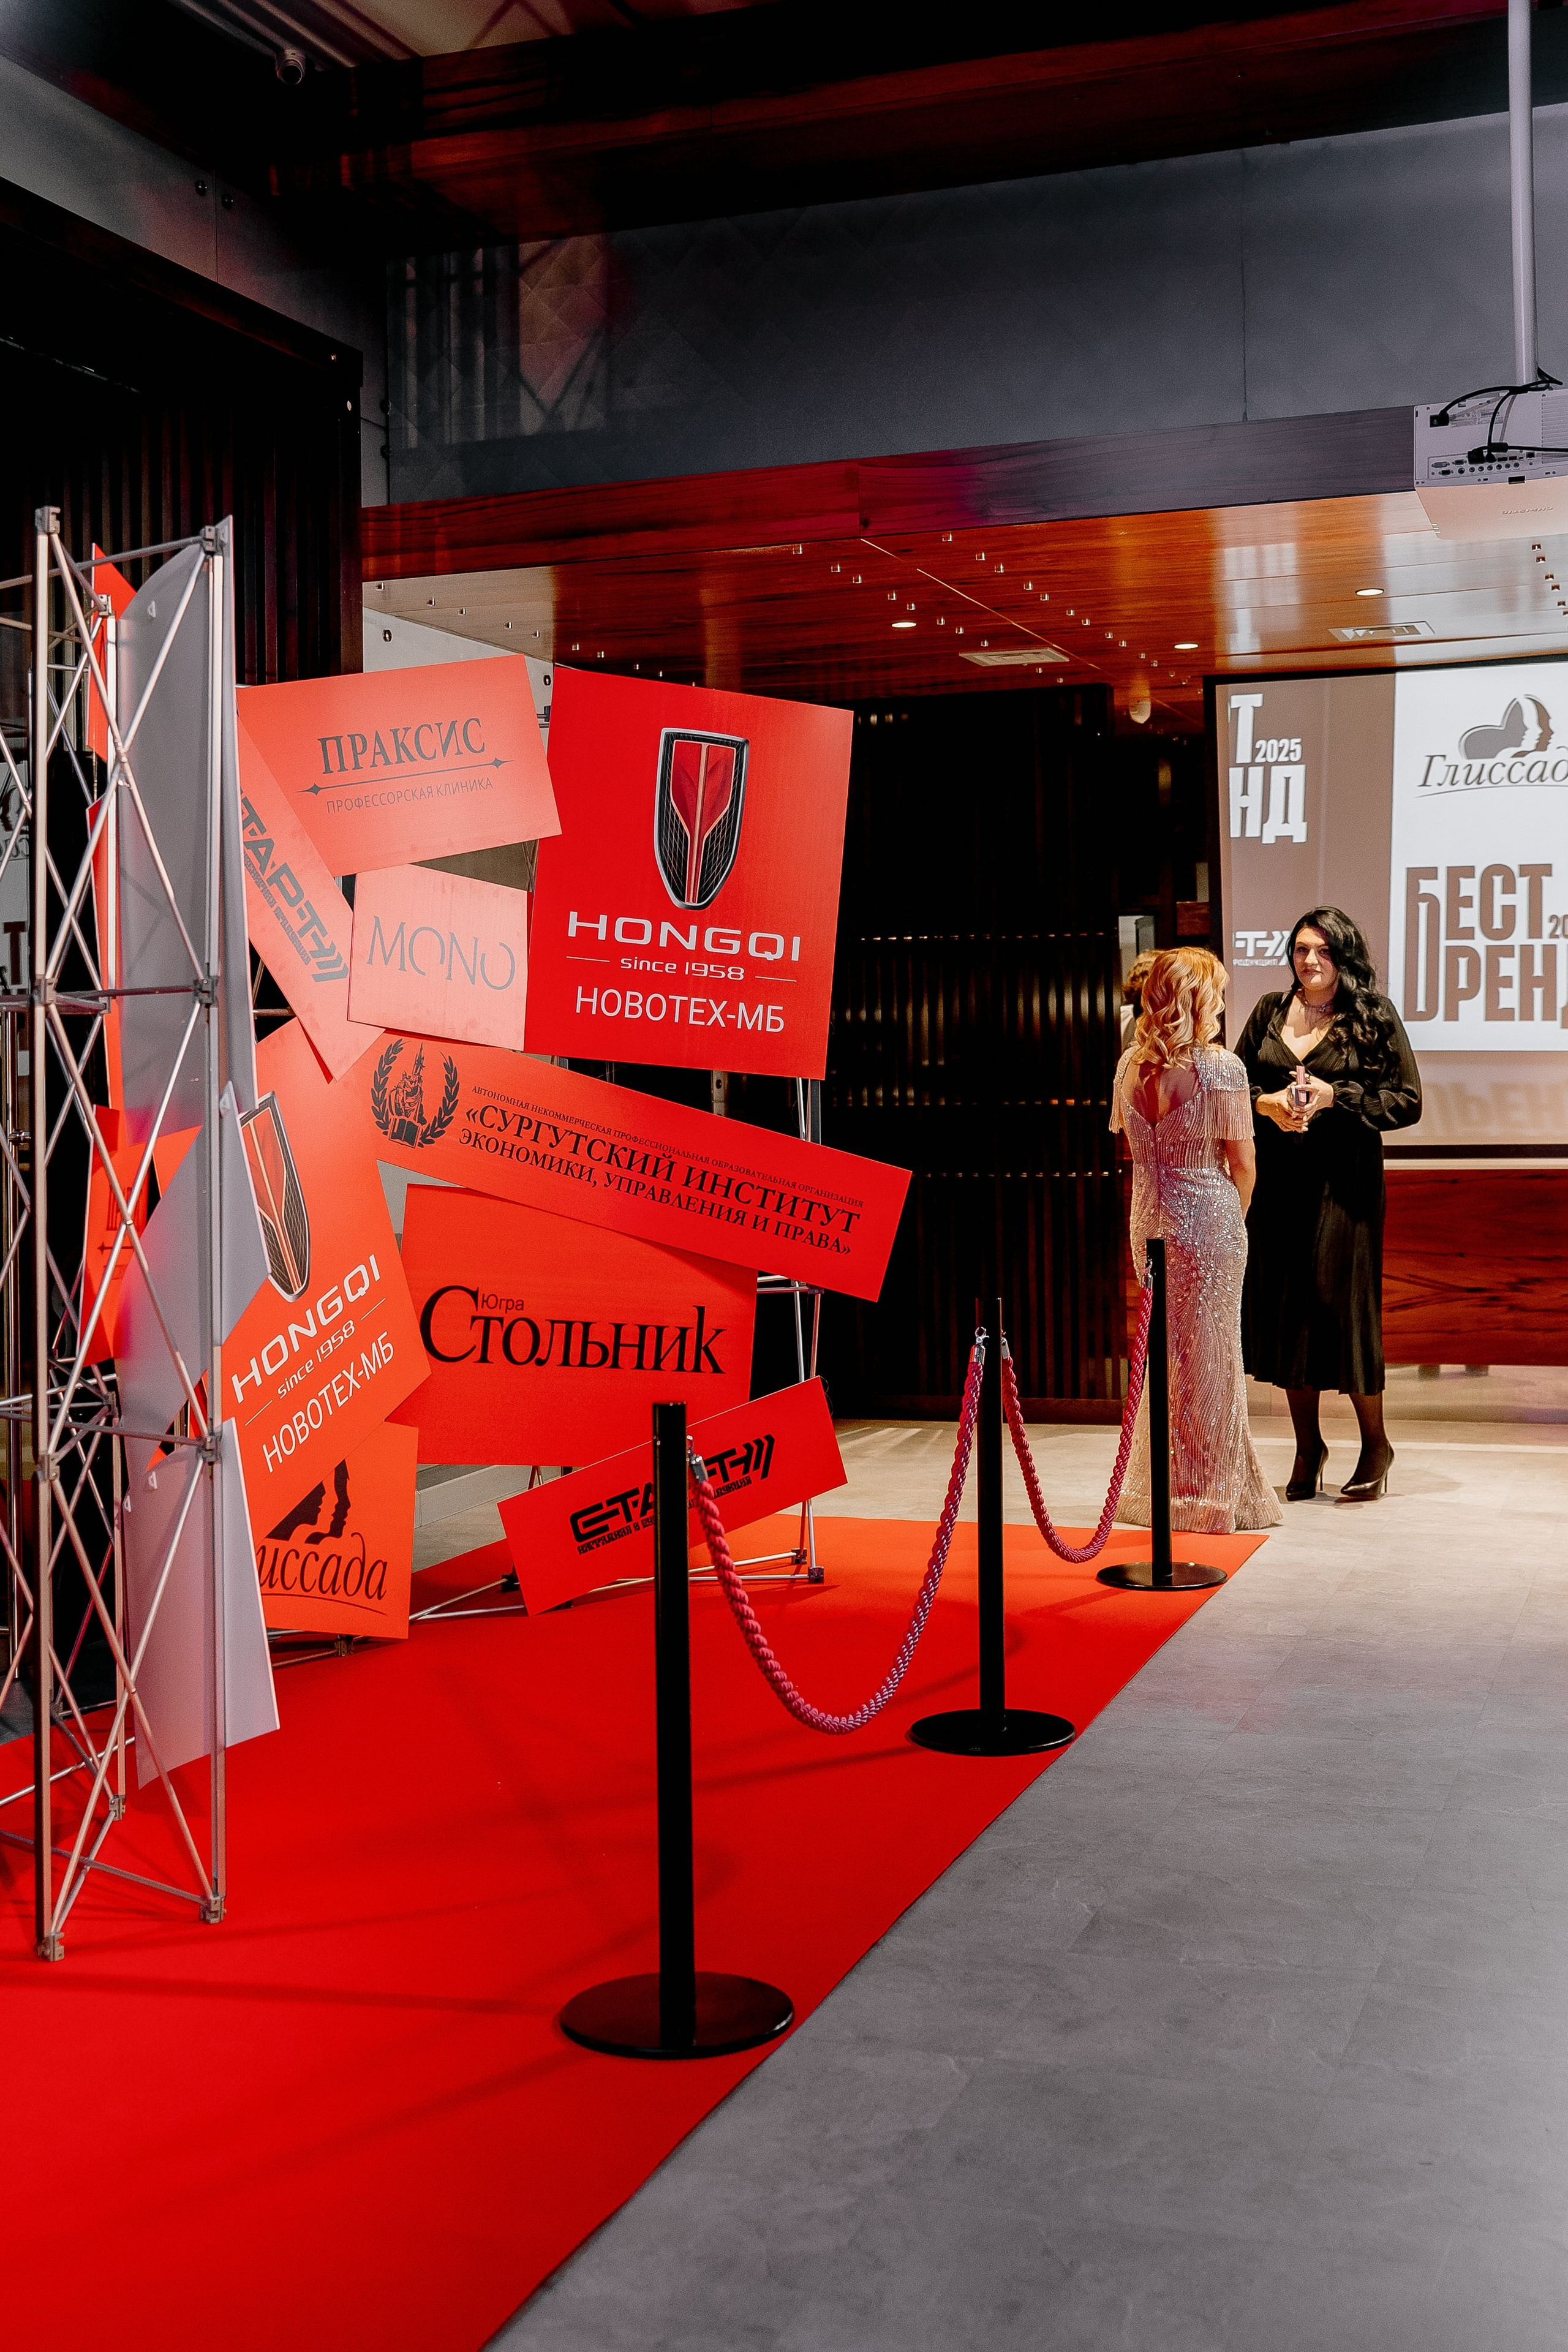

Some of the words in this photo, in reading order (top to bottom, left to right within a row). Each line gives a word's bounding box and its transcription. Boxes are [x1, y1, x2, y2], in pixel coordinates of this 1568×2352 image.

[317, 717, 486, 775] ПРАКСИС
[1254, 737, 1302, 763] 2025
[326, 786, 432, 814] ПРОФЕССОРСКАЯ
[435, 777, 494, 797] КЛИНИКА
[241, 786, 328, 938] ТАРТ
[367, 916, 515, 990] MONO
[567, 911, 801, 962] HONGQI
[620, 956, 677, 974] since
[685, 961, 745, 981] 1958
[576, 986, 785, 1033] НОВОТЕХ-МБ
[466, 1104, 677, 1183] «СУРГУТСКИЙ
[682, 1165, 861, 1234] ИНСТИТУТ
[472, 1085, 530, 1110] АВТОНОМНАЯ
[530, 1104, 612, 1135] НЕКОММЕРЧЕСКАЯ
[613, 1129, 711, 1164] ПРОФЕССИОНАЛЬНАЯ
[711, 1159, 797, 1189] ОБРАЗОВАТЕЛЬНАЯ
[797, 1183, 864, 1209] ОРГАНИЗАЦИЯ
[459, 1128, 598, 1188] ЭКОНОМИКИ,
[604, 1172, 748, 1226] УПРАВЛЕНИЯ
[751, 1215, 769, 1233] И
[772, 1220, 851, 1255] ПРАВА»
[231, 1254, 381, 1404] HONGQI
[420, 1285, 728, 1374] Стольник
[481, 1293, 524, 1314] Югра
[277, 1359, 315, 1400] since
[316, 1319, 355, 1363] 1958
[262, 1331, 394, 1474] НОВОТЕХ-МБ
[569, 1447, 737, 1543] СТТ
[256, 1532, 388, 1601] иссада
